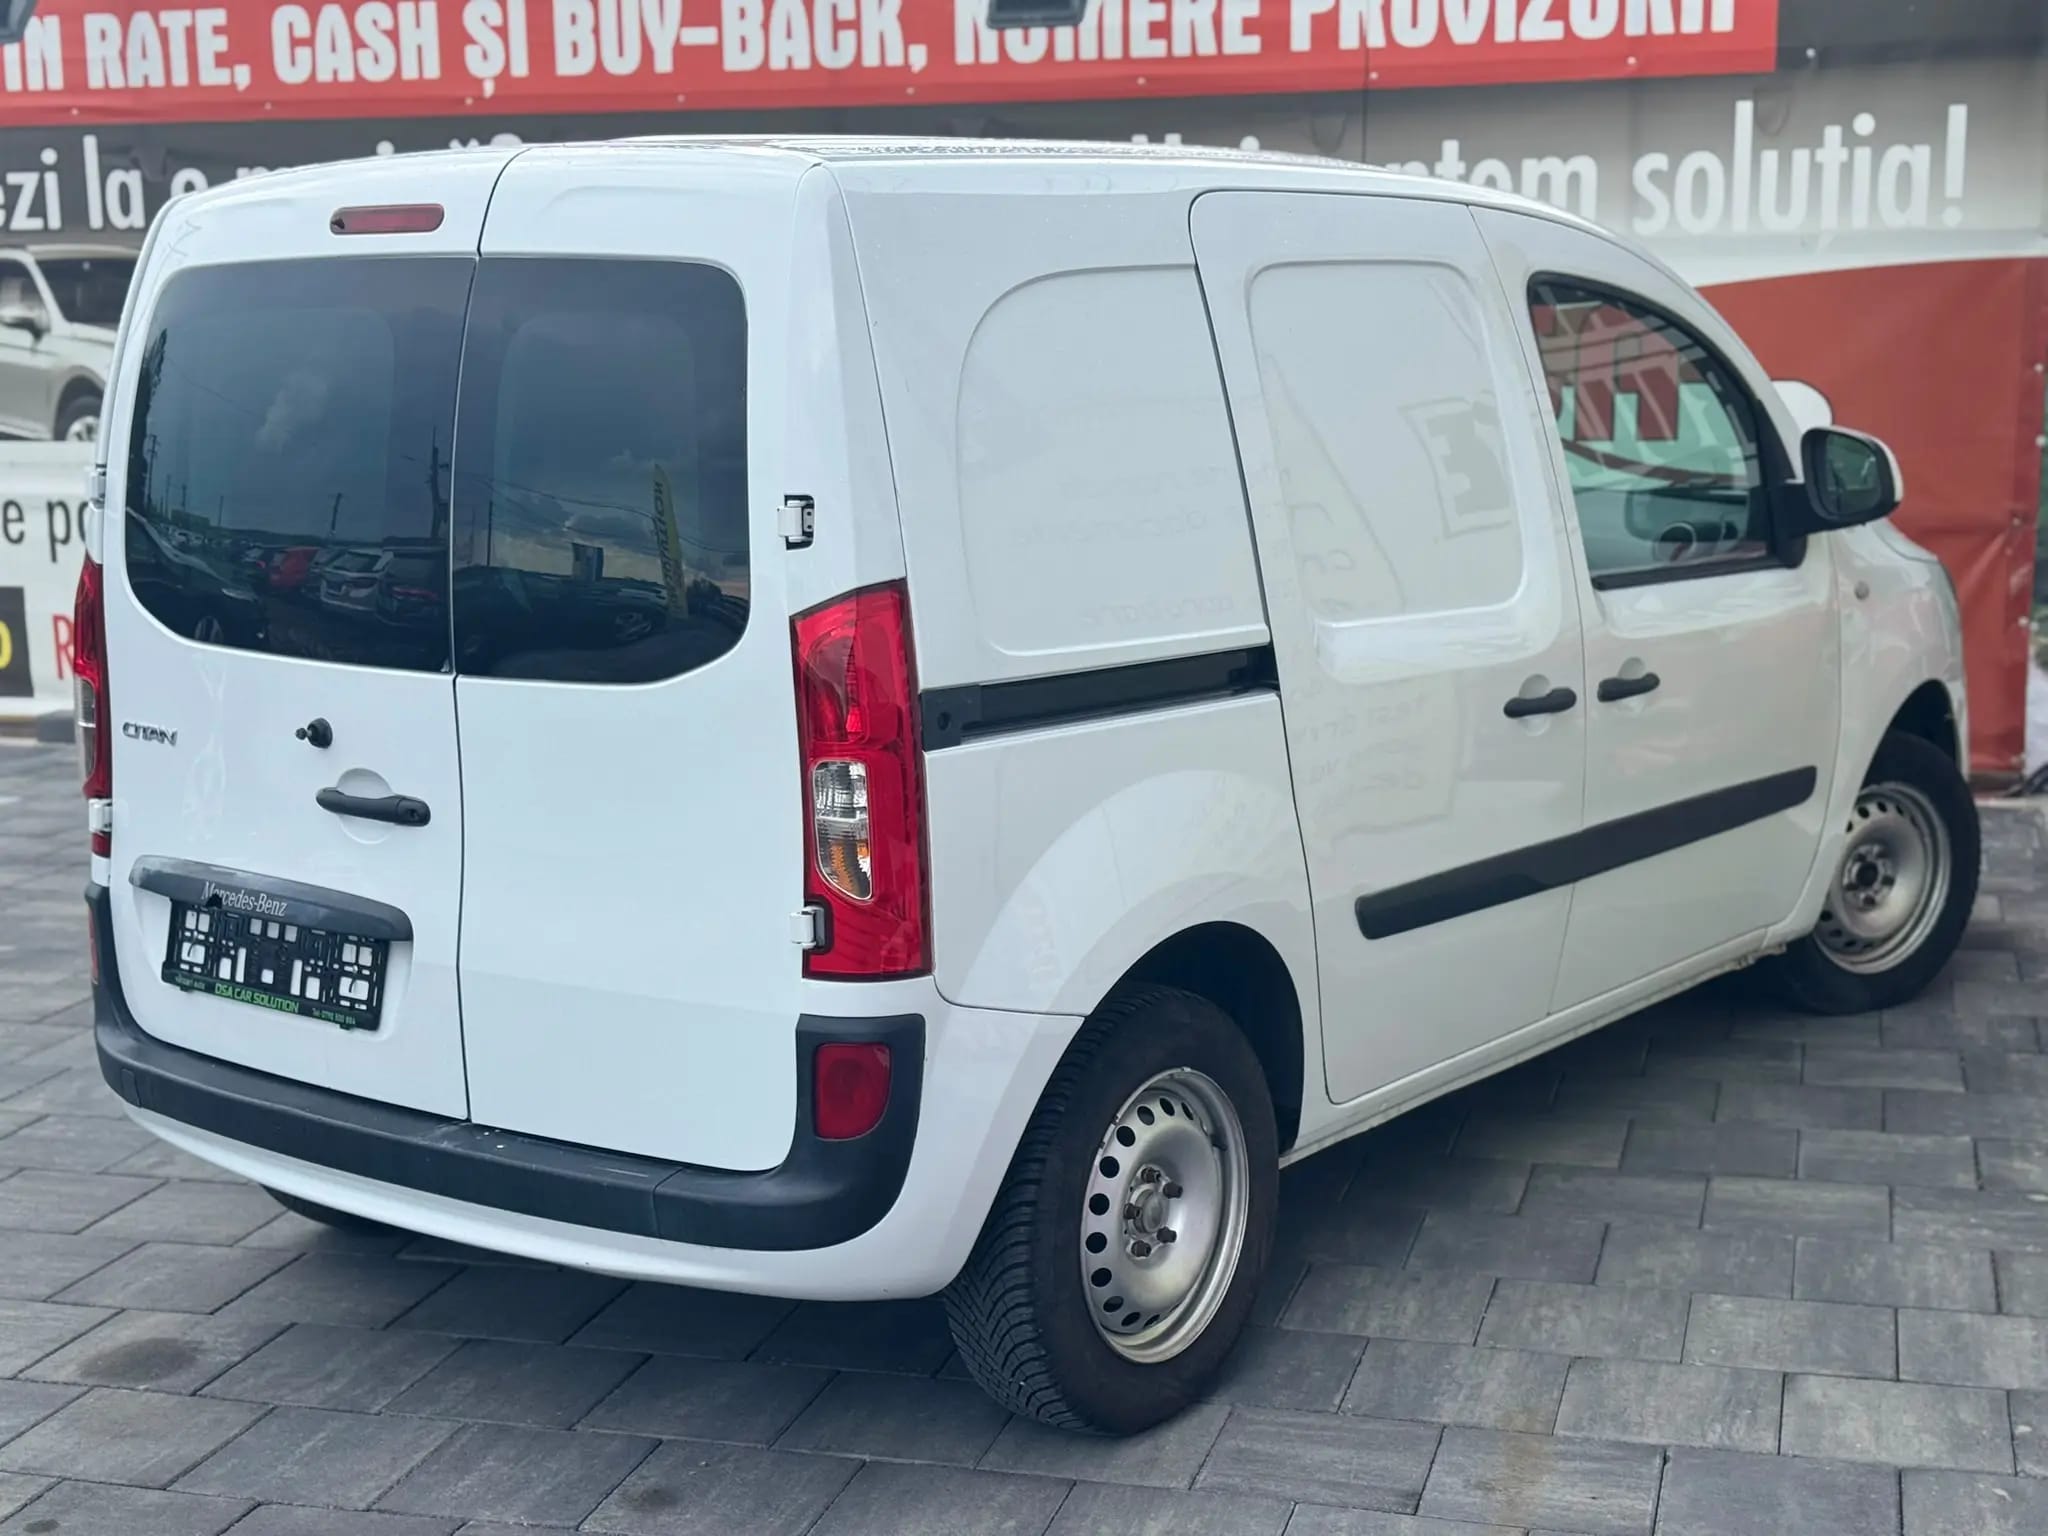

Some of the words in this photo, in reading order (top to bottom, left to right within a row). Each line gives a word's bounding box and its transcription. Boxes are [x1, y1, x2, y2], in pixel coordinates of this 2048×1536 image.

[83, 9, 251, 91] RATE,
[271, 1, 441, 84] CASH
[0, 147, 62, 230] zi
[83, 134, 146, 230] la
[122, 722, 178, 747] CITAN
[234, 988, 252, 1003] CAR
[253, 993, 300, 1013] SOLUTION
